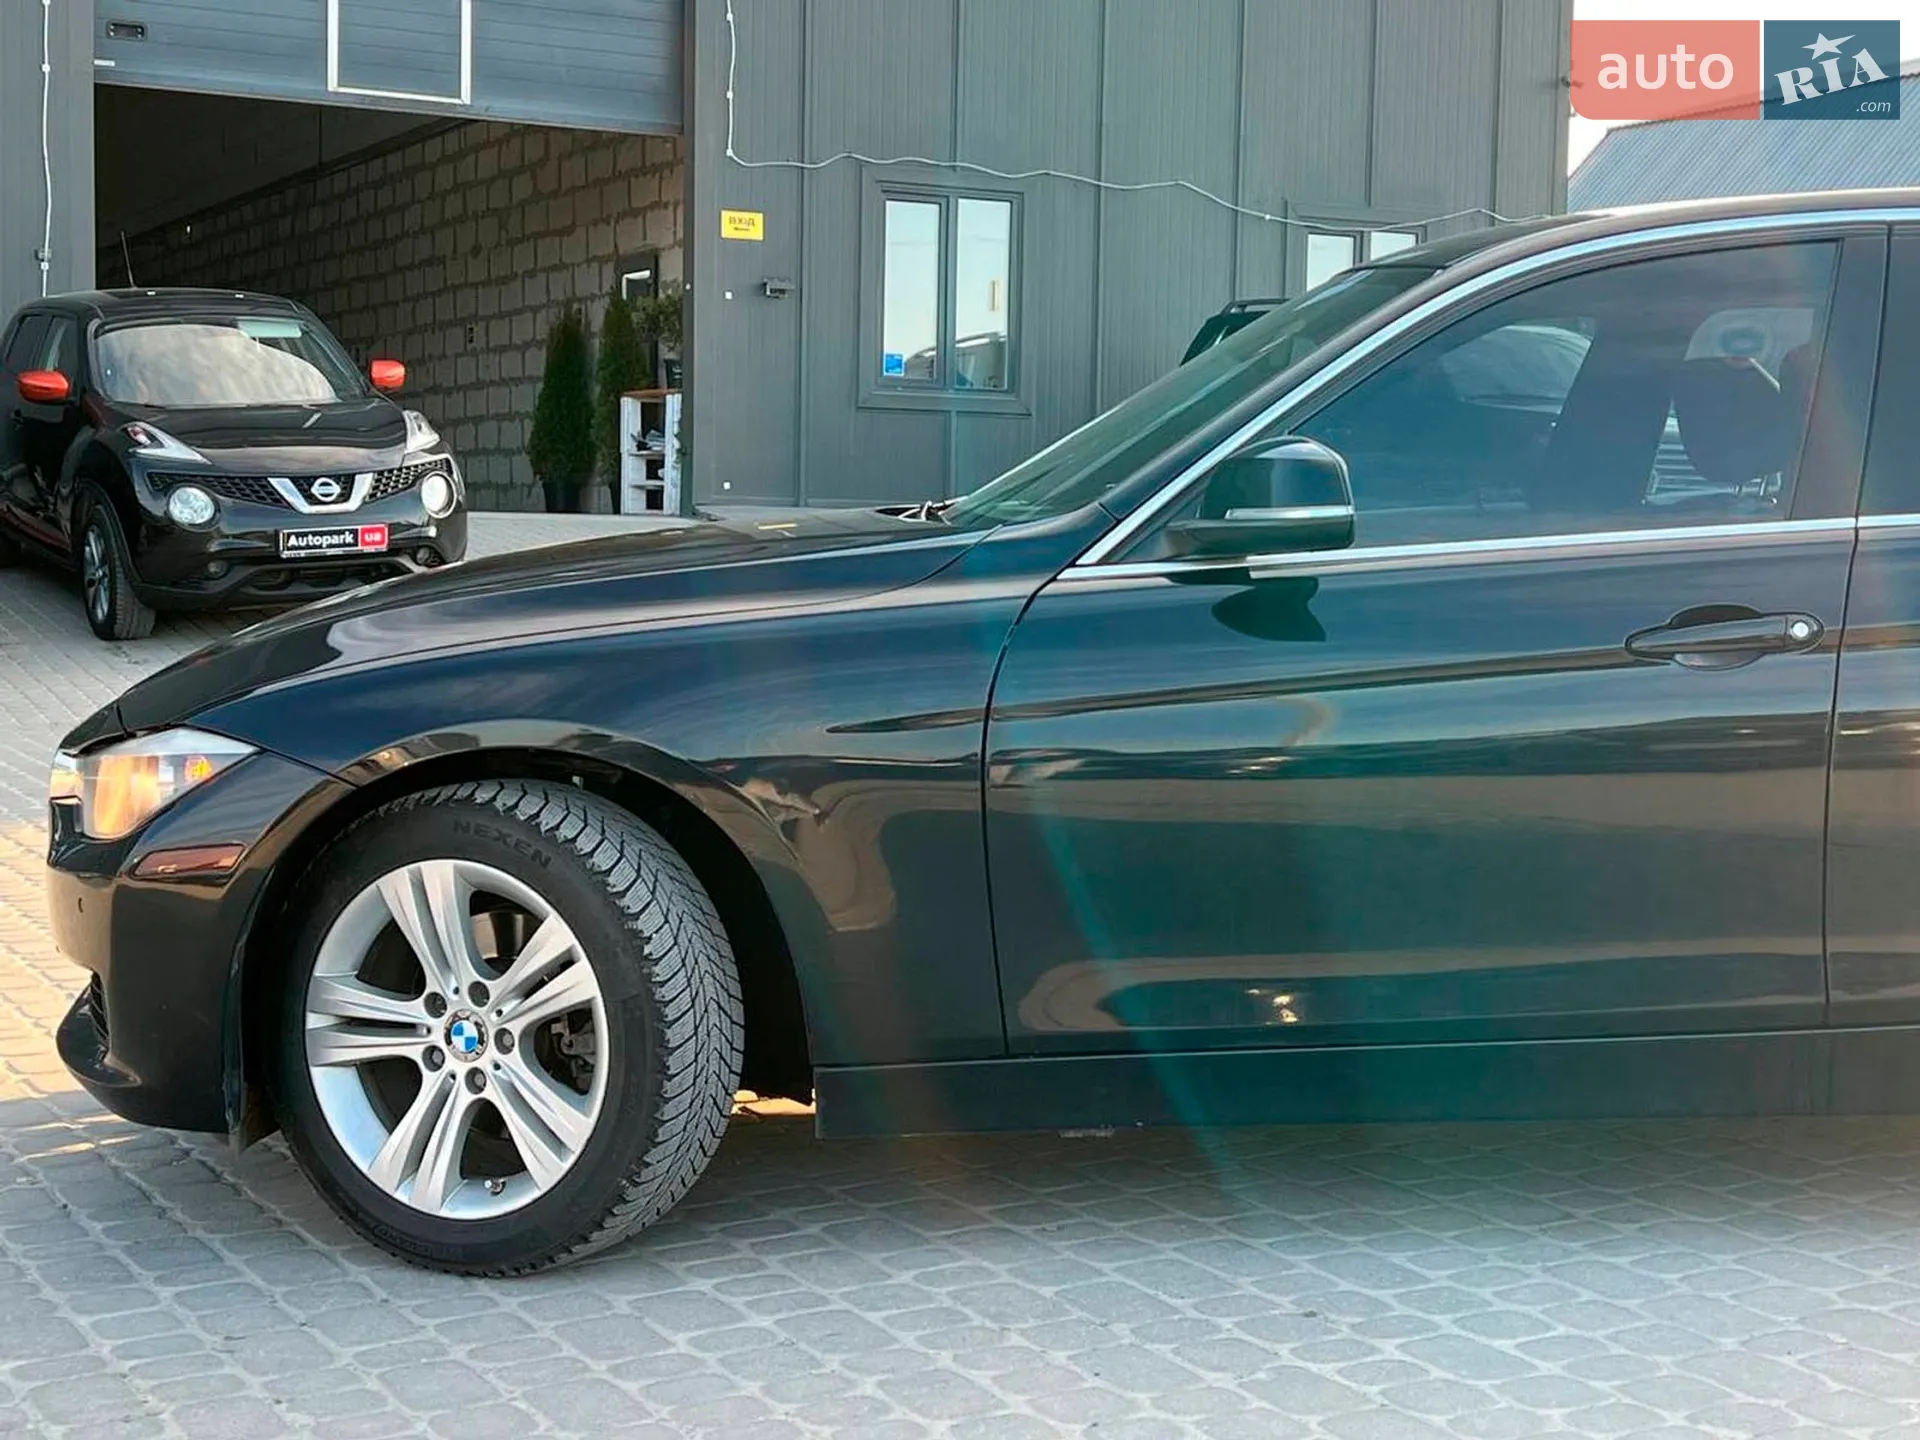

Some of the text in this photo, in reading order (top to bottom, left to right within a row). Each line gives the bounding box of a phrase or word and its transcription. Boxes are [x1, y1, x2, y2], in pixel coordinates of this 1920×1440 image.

[287, 531, 383, 548] Autopark ua
[453, 820, 552, 869] NEXEN
